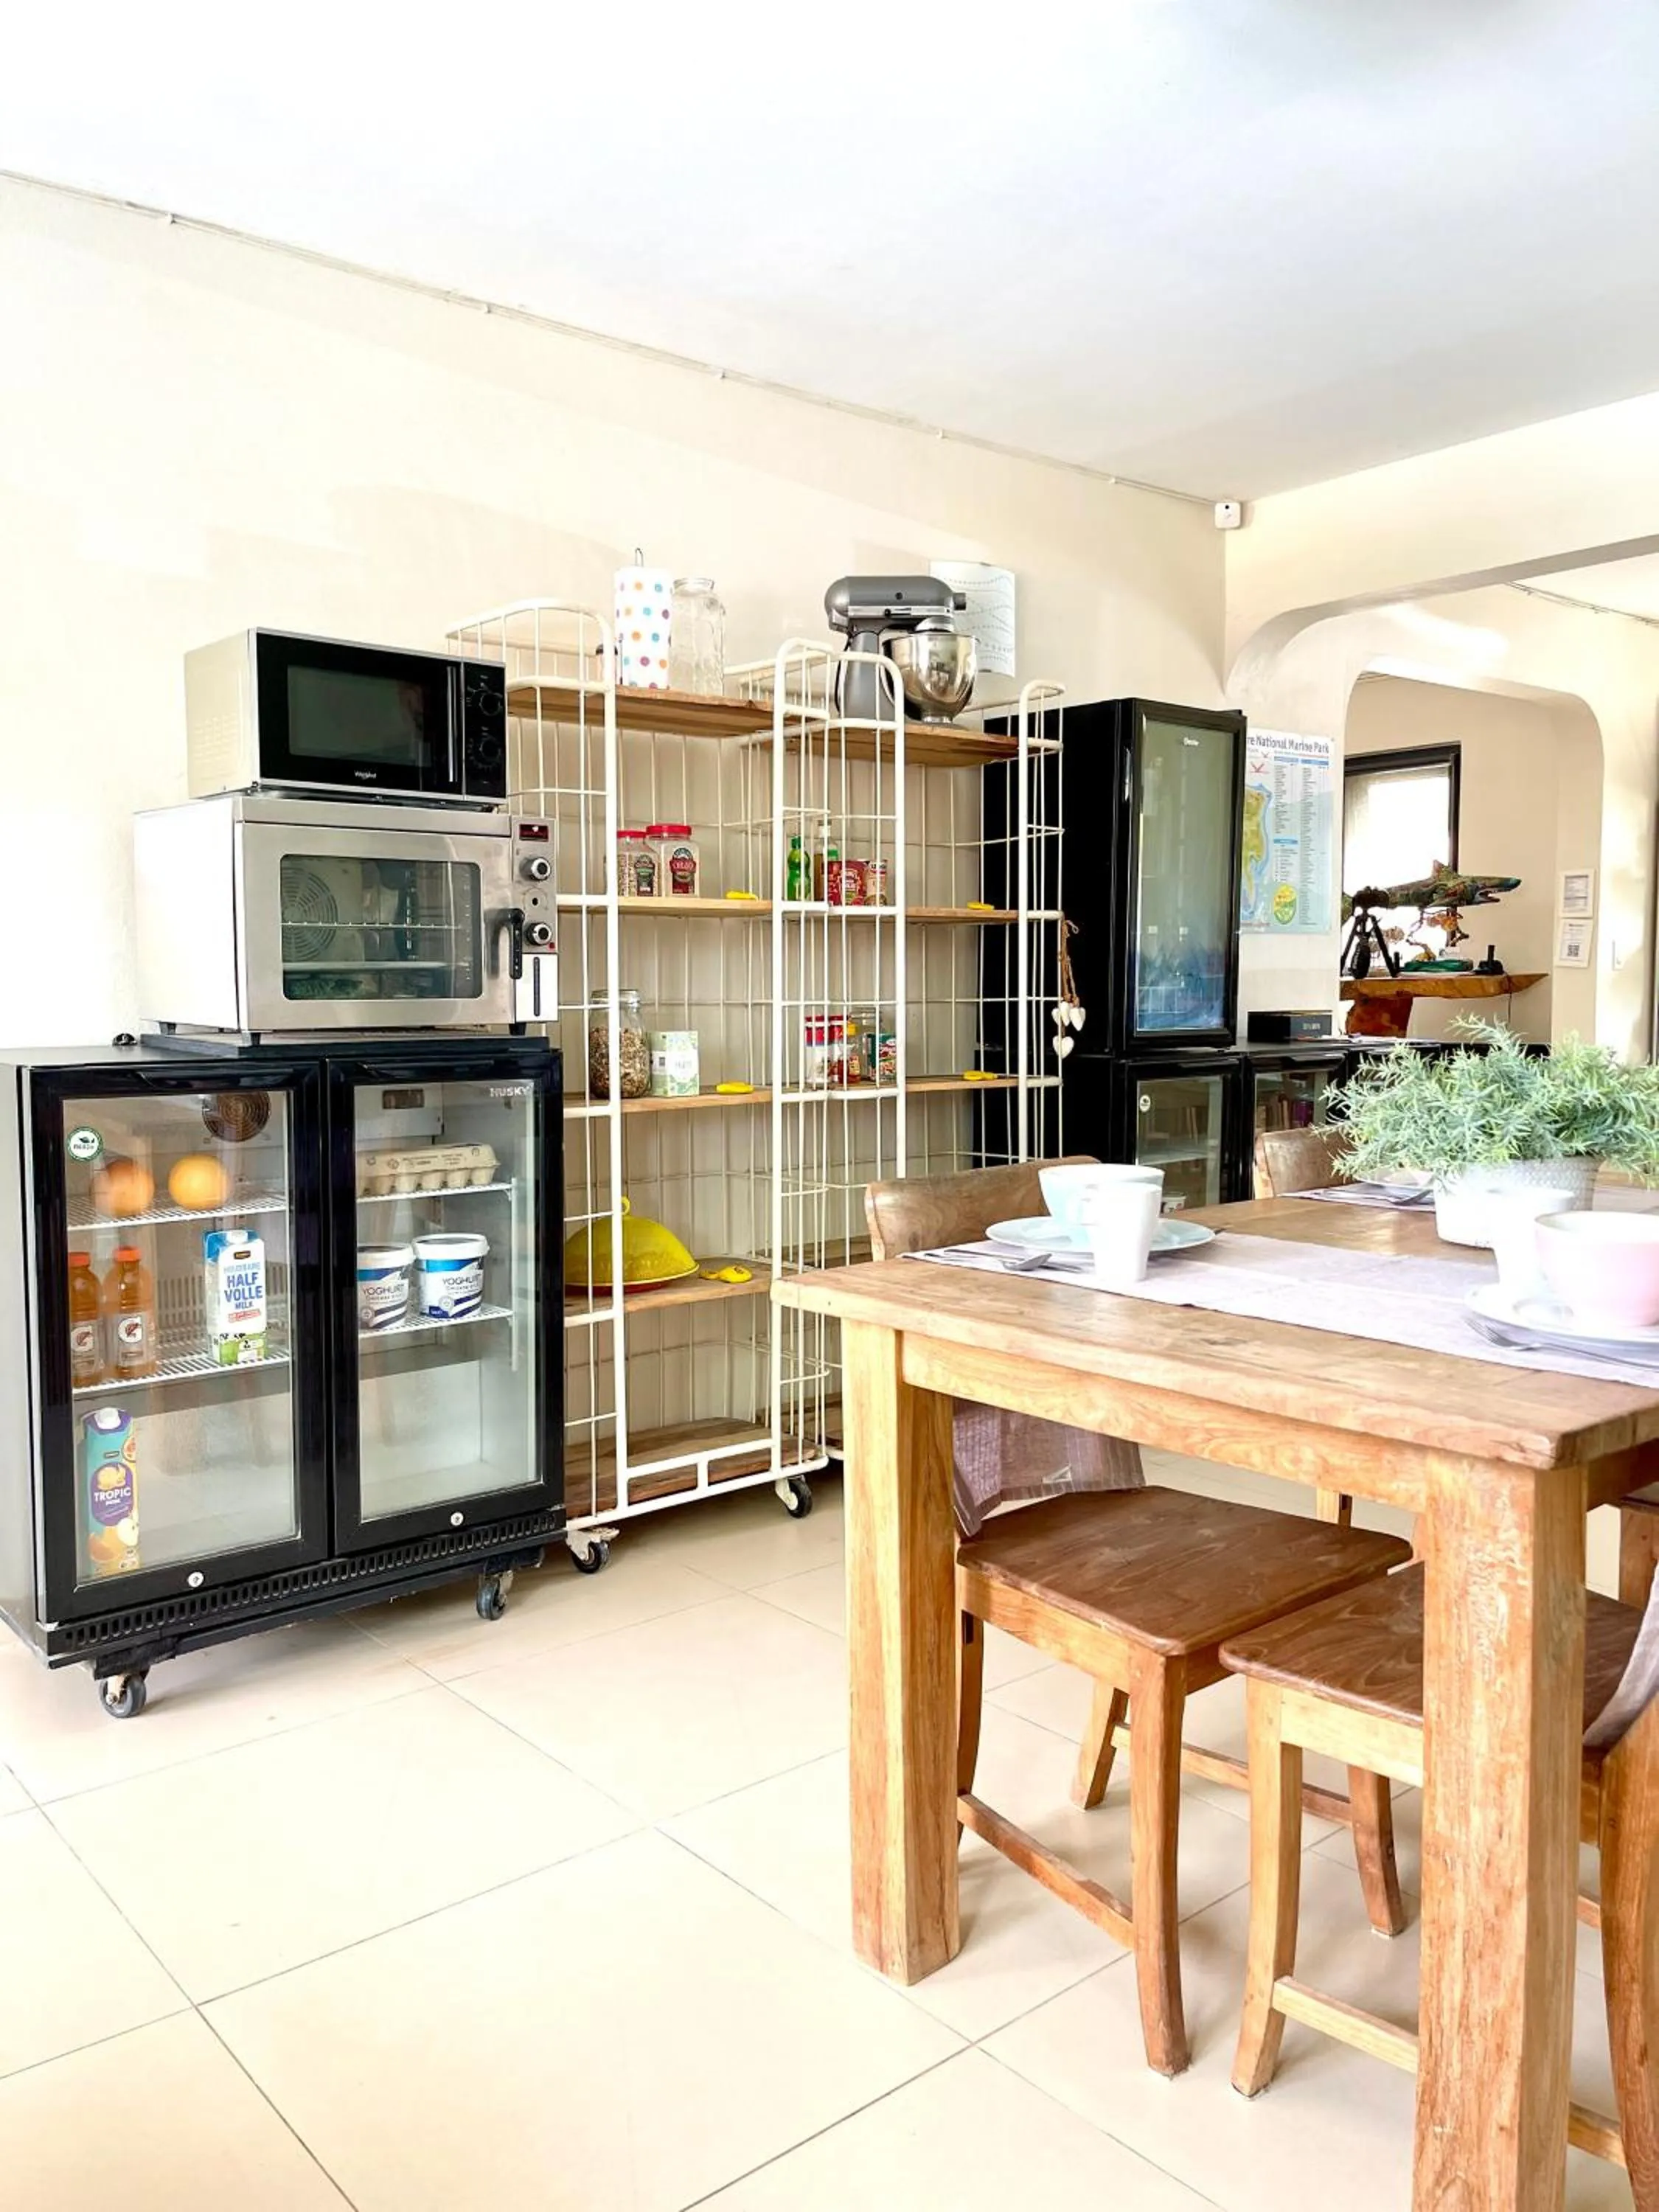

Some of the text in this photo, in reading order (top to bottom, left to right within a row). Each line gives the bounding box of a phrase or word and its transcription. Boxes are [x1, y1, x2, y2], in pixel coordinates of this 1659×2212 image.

[1256, 734, 1287, 750] National
[1288, 738, 1312, 753] Marine
[1313, 742, 1329, 754] Park
[227, 1272, 259, 1288] HALF
[224, 1285, 263, 1303] VOLLE
[94, 1487, 131, 1502] TROPIC
